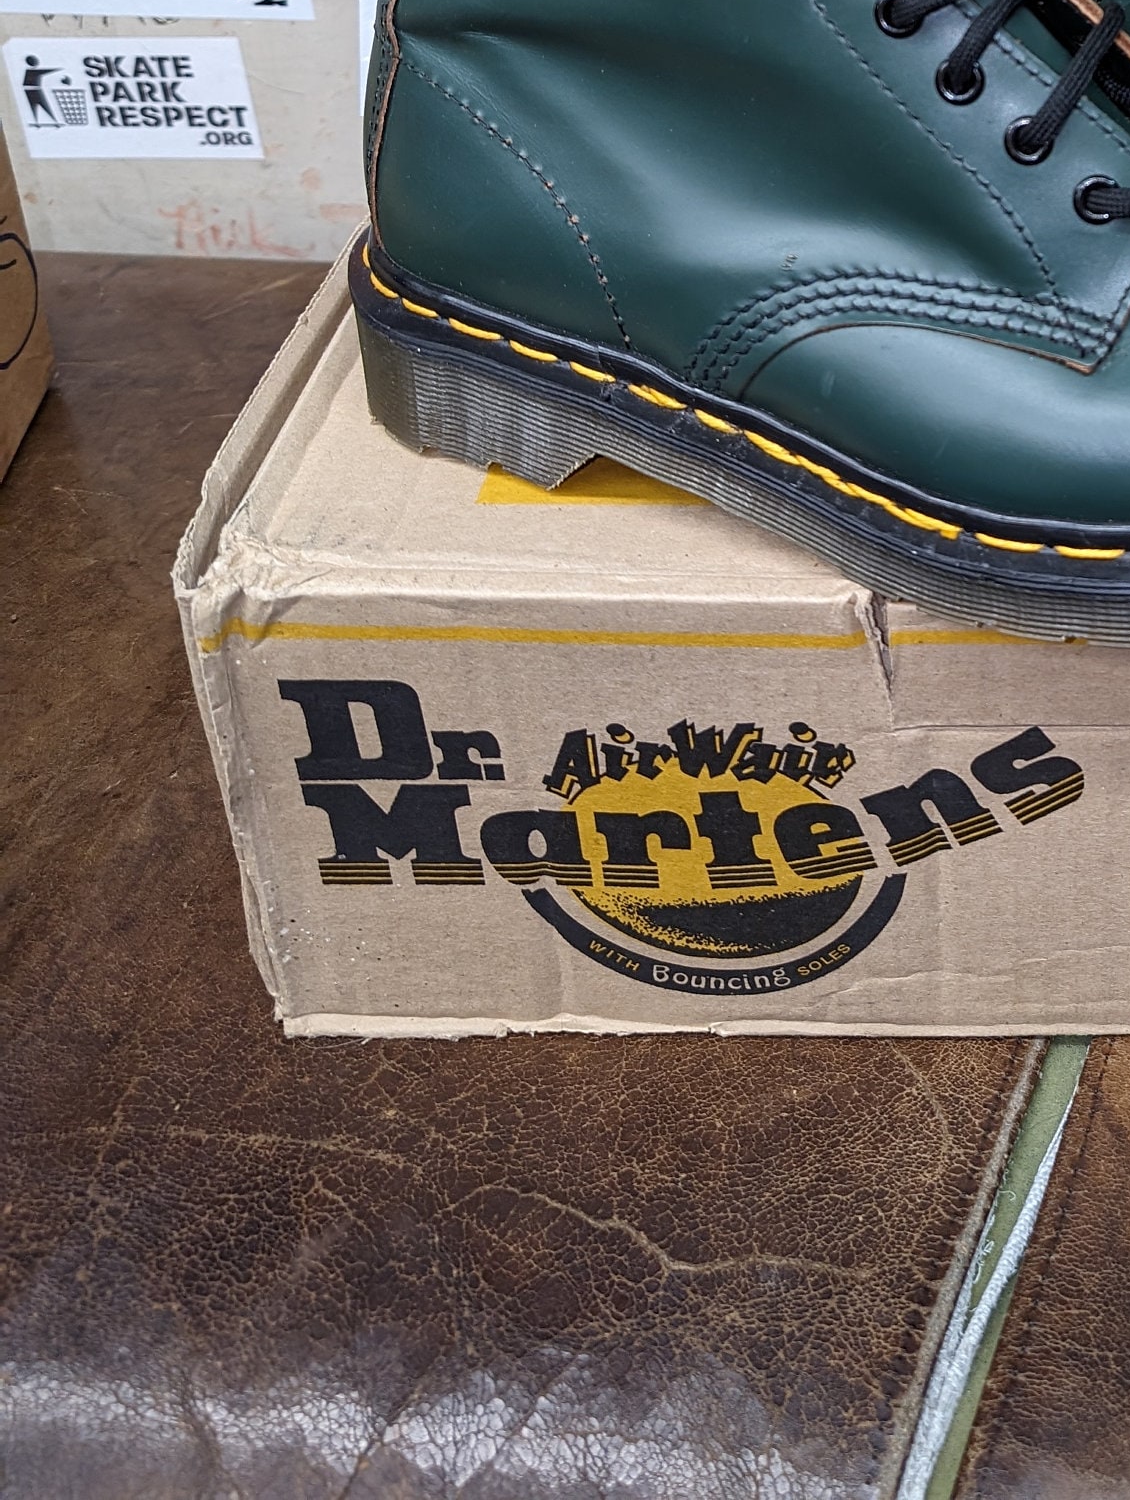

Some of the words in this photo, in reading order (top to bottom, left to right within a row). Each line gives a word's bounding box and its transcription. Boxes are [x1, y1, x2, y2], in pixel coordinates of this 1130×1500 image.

[83, 55, 194, 78] SKATE
[89, 81, 187, 103] PARK
[96, 105, 248, 128] RESPECT
[200, 131, 253, 146] .ORG
[277, 679, 506, 781] Dr.
[543, 718, 857, 798] AirWair
[300, 726, 1085, 888] Martens
[590, 939, 640, 972] WITH
[652, 964, 791, 990] Bouncing
[796, 943, 852, 977] SOLES
